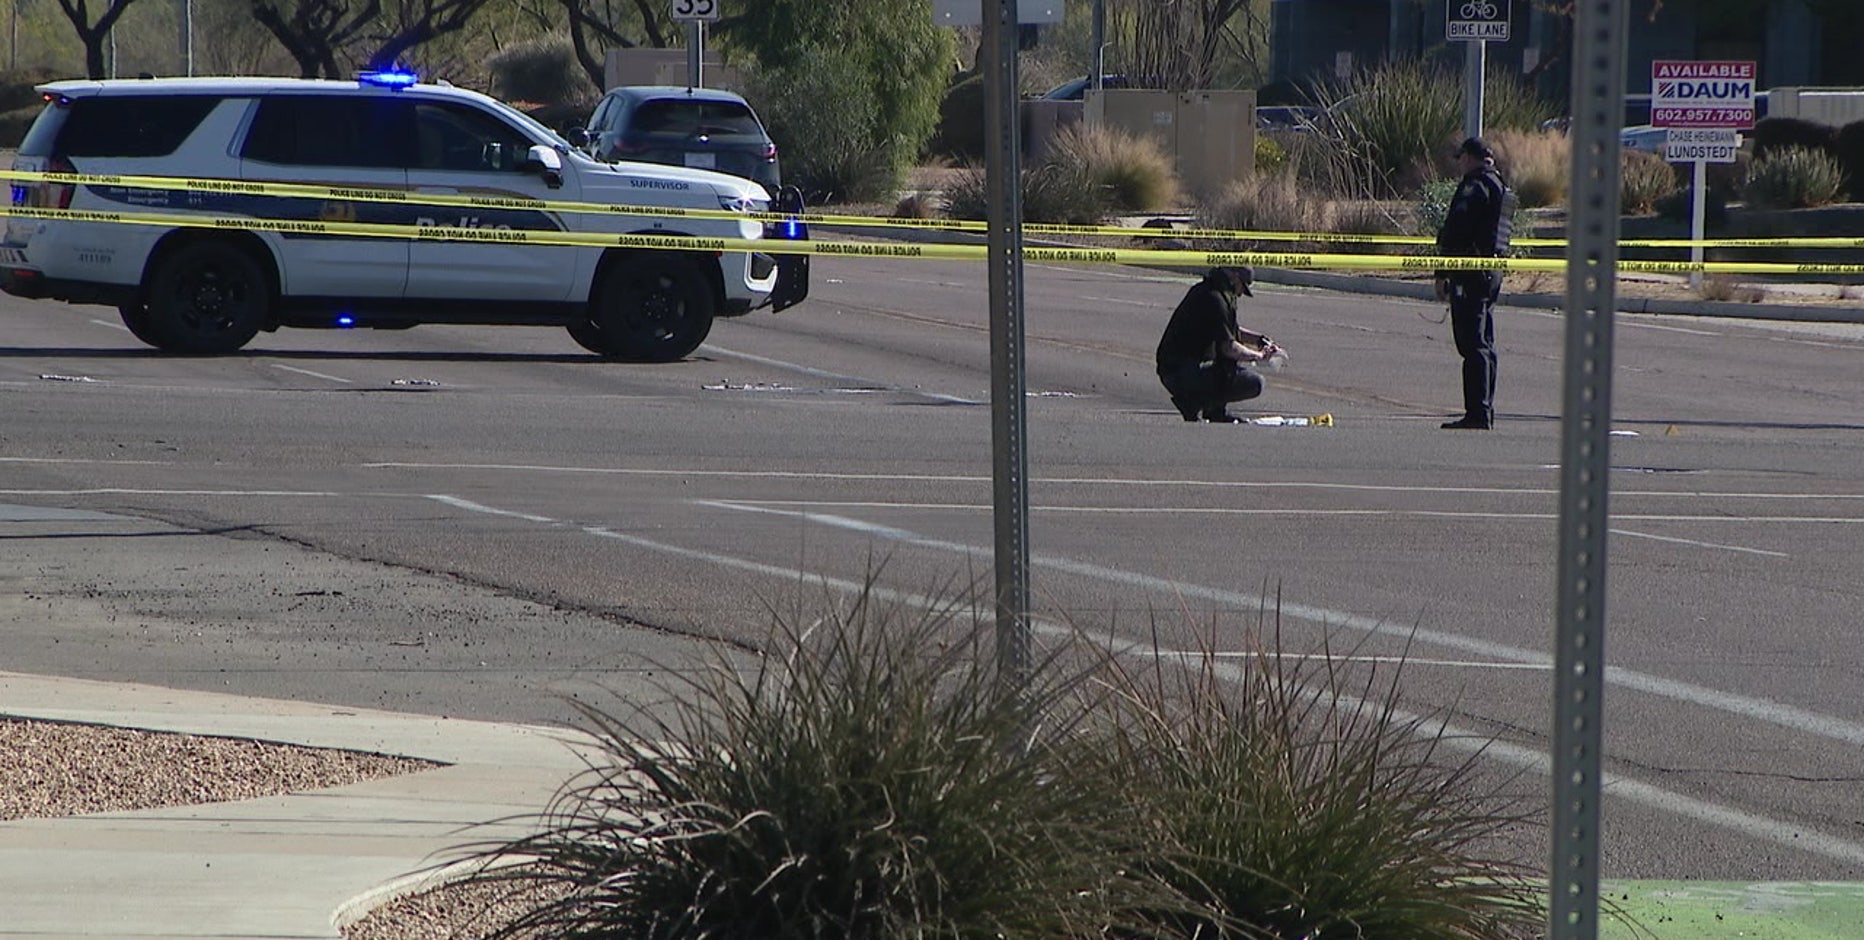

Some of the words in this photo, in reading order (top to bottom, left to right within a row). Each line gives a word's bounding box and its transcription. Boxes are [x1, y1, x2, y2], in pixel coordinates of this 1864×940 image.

[677, 0, 713, 15] 35
[1451, 24, 1474, 35] BIKE
[1478, 24, 1505, 35] LANE
[1659, 65, 1750, 77] AVAILABLE
[1677, 82, 1750, 99] DAUM
[1656, 110, 1752, 121] 602.957.7300
[1668, 146, 1734, 158] LUNDSTEDT
[187, 181, 207, 189] POLICE
[208, 182, 221, 190] LINE
[222, 182, 230, 190] DO
[233, 183, 244, 191] NOT
[245, 184, 264, 192] CROSS
[630, 180, 690, 191] SUPERVISOR
